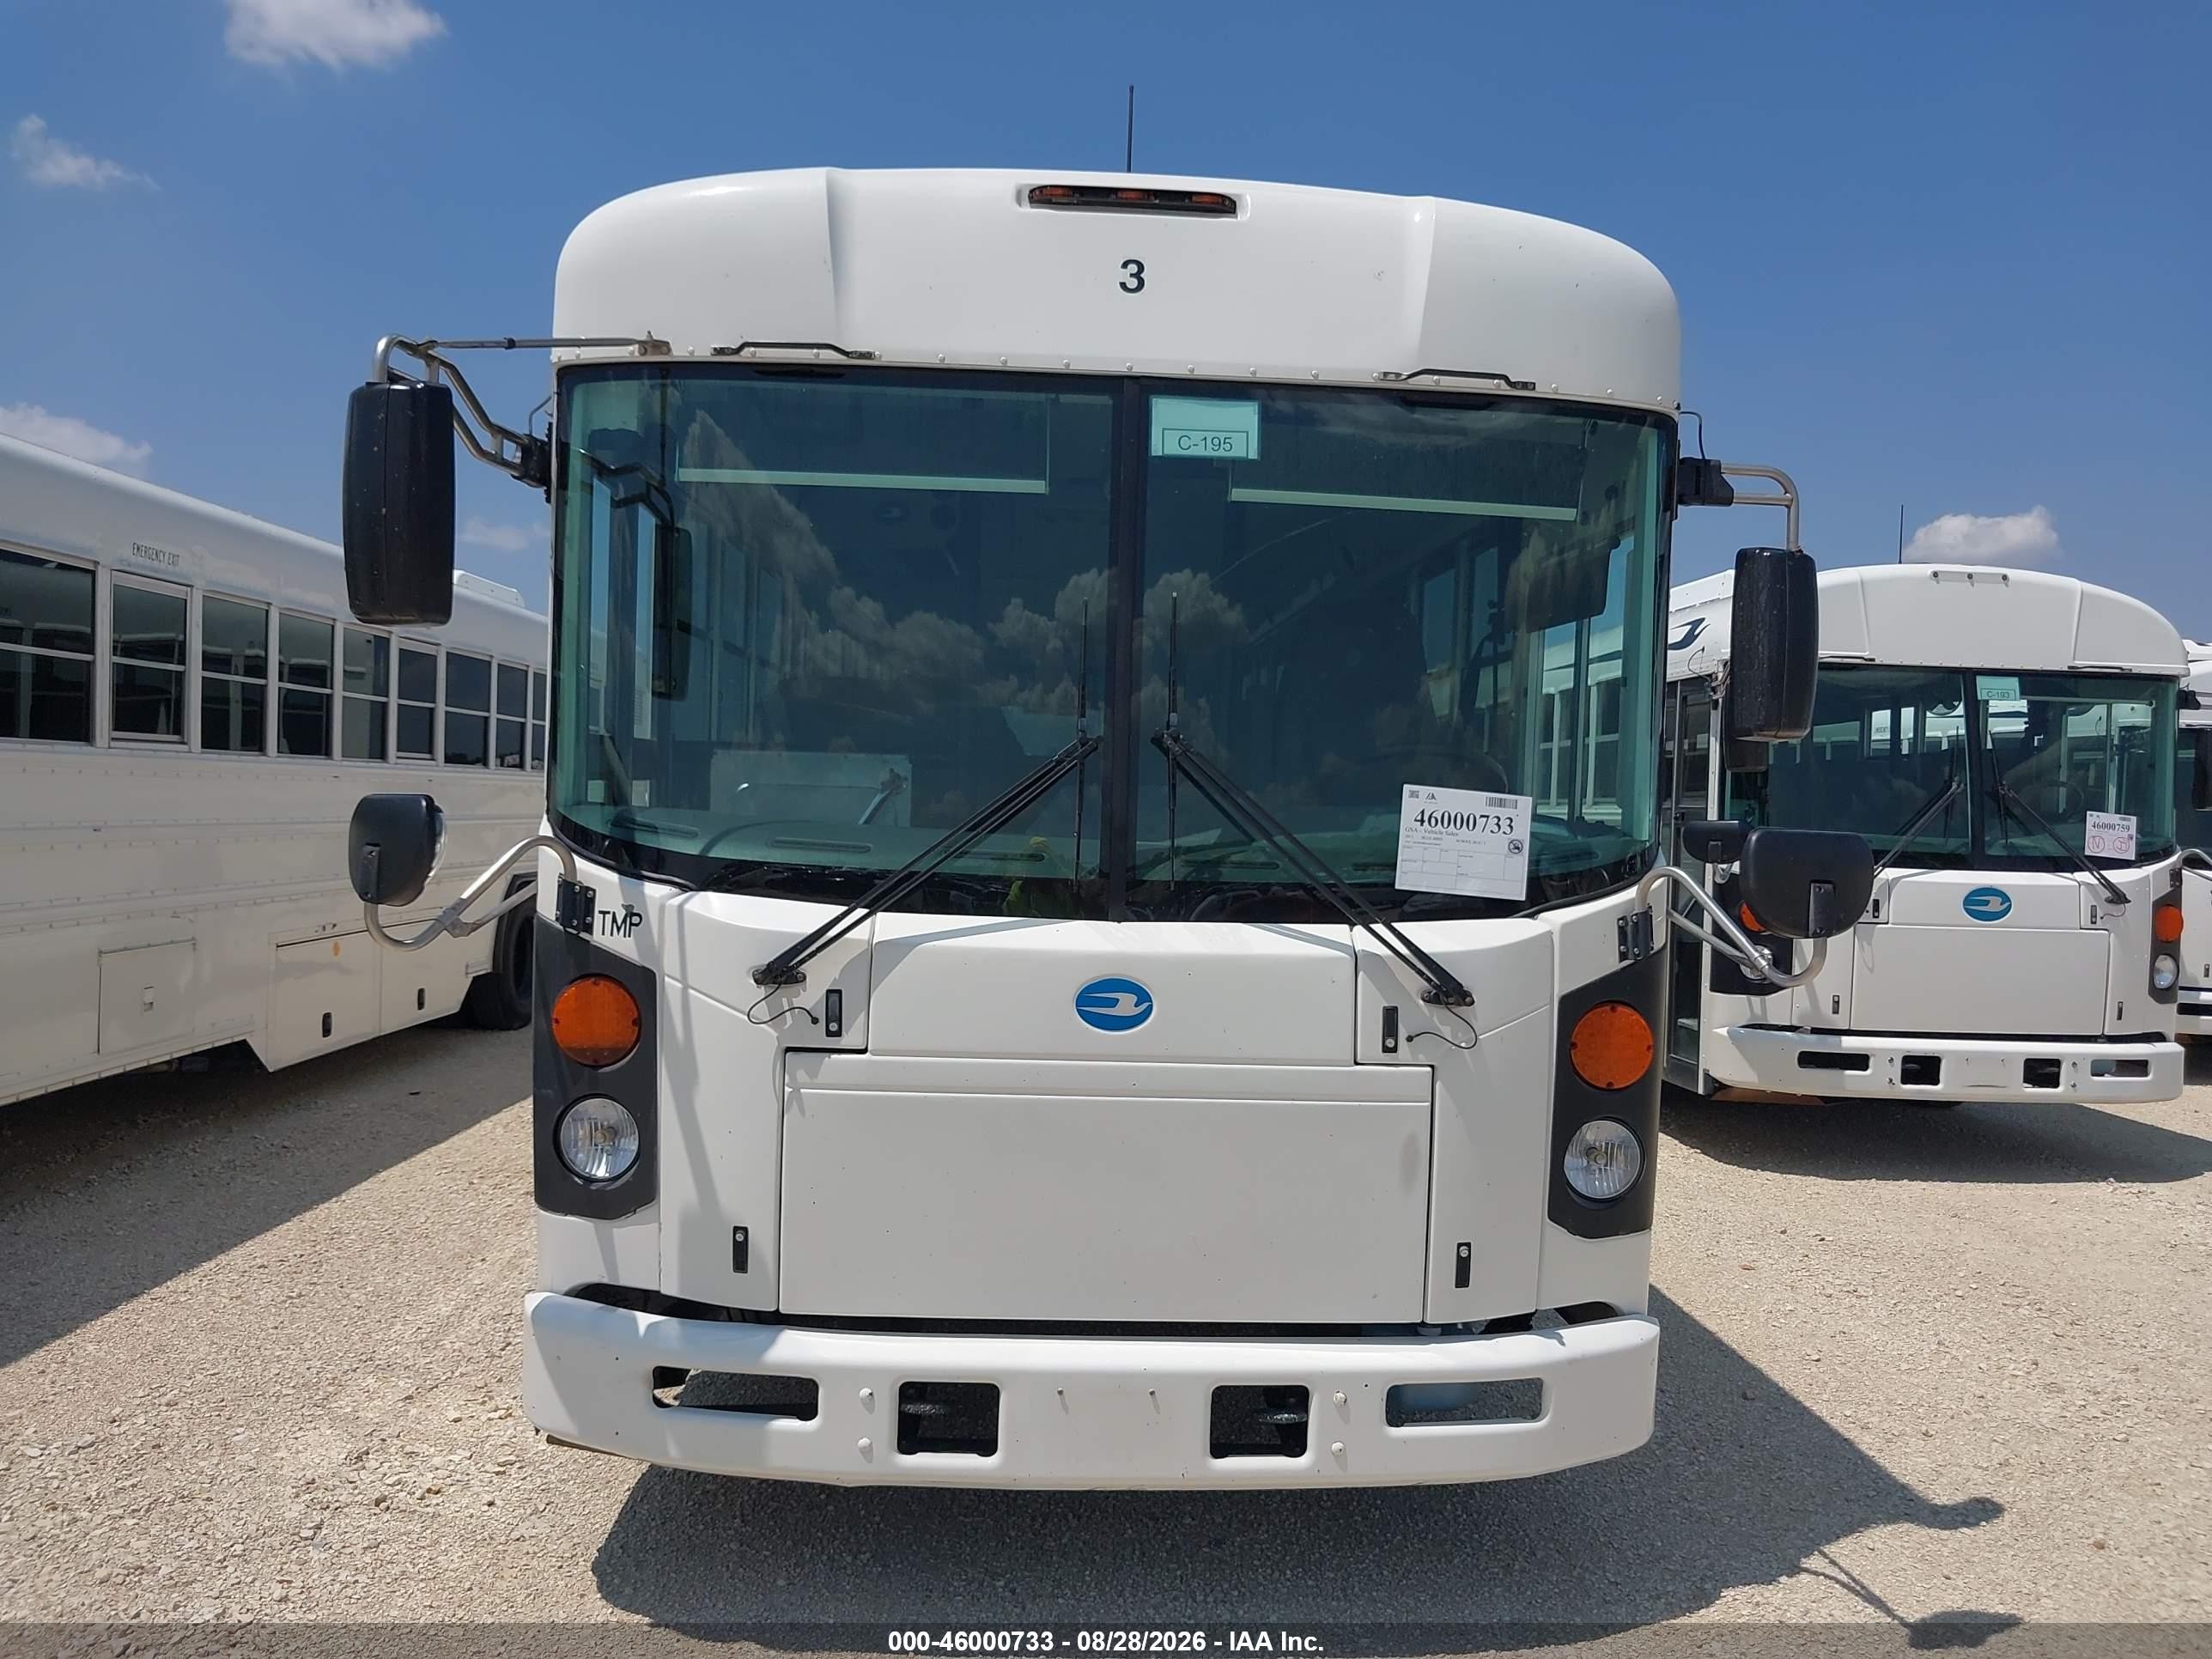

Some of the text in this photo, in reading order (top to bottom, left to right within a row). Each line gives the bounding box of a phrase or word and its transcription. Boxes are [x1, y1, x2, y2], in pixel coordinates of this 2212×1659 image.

[1118, 258, 1146, 295] 3
[1177, 434, 1233, 453] C-195
[132, 542, 179, 567] EMERGENCY EXIT
[1413, 808, 1514, 836] 46000733
[2091, 820, 2130, 833] 46000759
[598, 909, 643, 939] TMP
